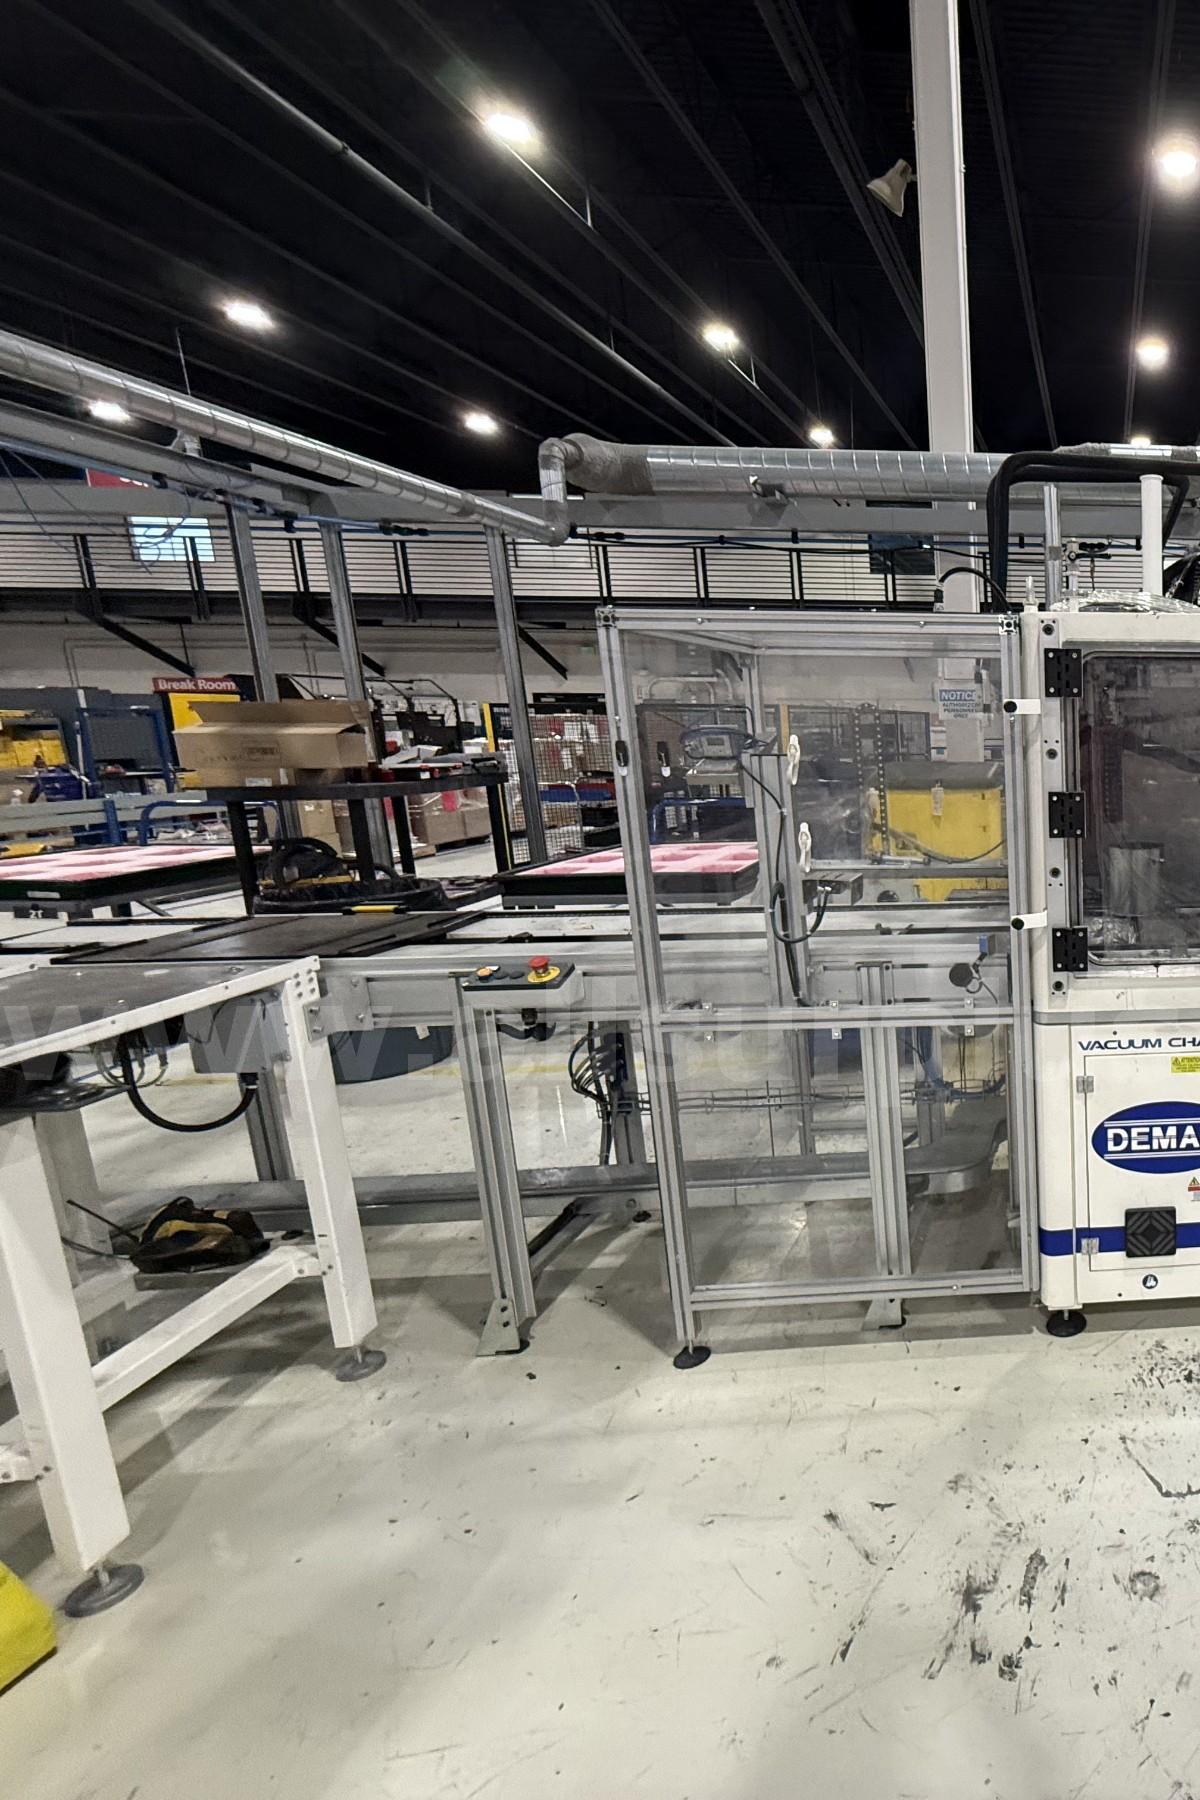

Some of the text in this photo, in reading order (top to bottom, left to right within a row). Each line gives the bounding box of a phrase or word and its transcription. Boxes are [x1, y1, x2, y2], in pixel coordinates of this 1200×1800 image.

[157, 679, 236, 690] Break Room
[1078, 1038, 1162, 1051] VACUUM
